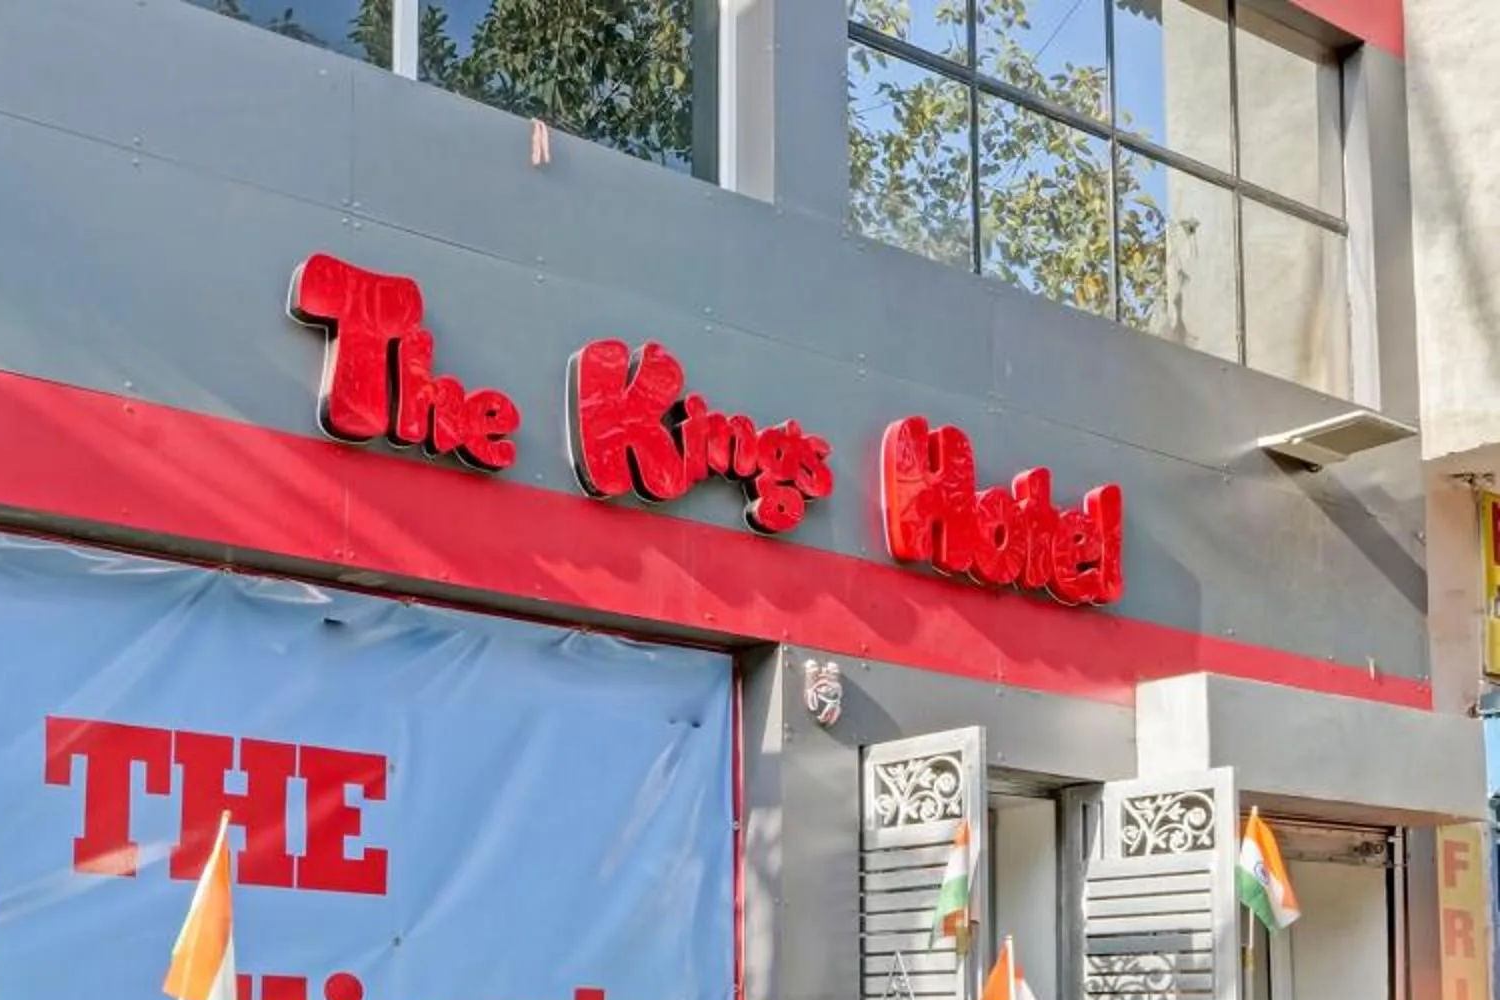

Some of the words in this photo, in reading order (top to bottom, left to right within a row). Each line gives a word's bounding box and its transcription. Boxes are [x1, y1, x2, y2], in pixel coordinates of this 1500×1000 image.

[288, 253, 521, 471] The
[880, 415, 1124, 606] Hotel
[45, 716, 387, 896] THE
